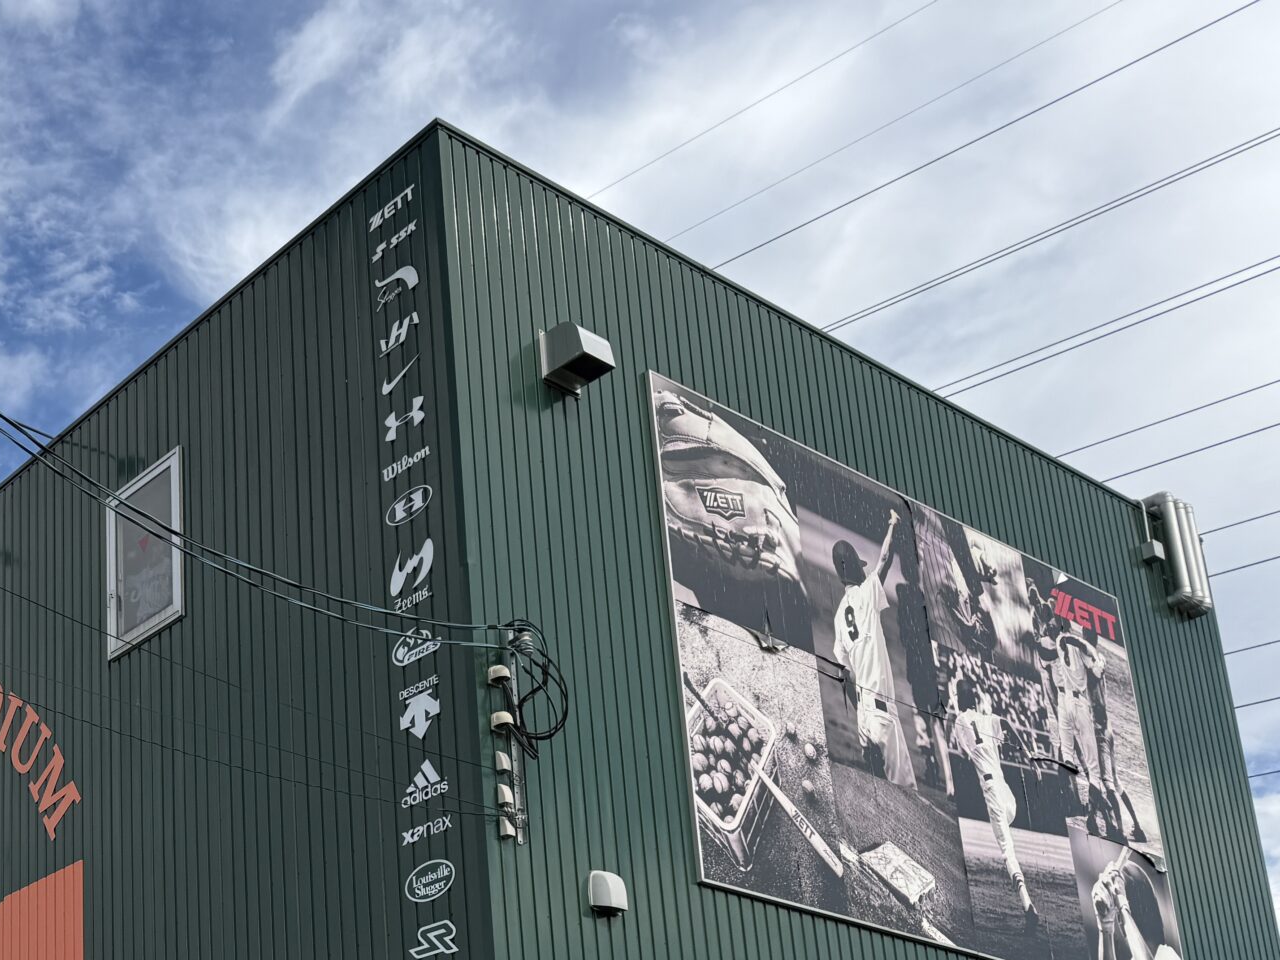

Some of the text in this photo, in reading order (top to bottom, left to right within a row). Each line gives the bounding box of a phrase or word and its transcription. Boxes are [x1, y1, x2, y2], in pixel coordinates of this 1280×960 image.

[369, 183, 415, 232] ZETT
[389, 219, 417, 249] SSK
[382, 445, 430, 482] Wilson
[703, 491, 742, 510] ZETT
[844, 605, 859, 642] 9
[1050, 588, 1117, 641] ZETT
[399, 674, 440, 701] DESCENTE
[401, 780, 449, 809] adidas
[792, 810, 816, 839] ZETT
[411, 864, 451, 888] Louisville
[414, 879, 447, 899] Slugger
